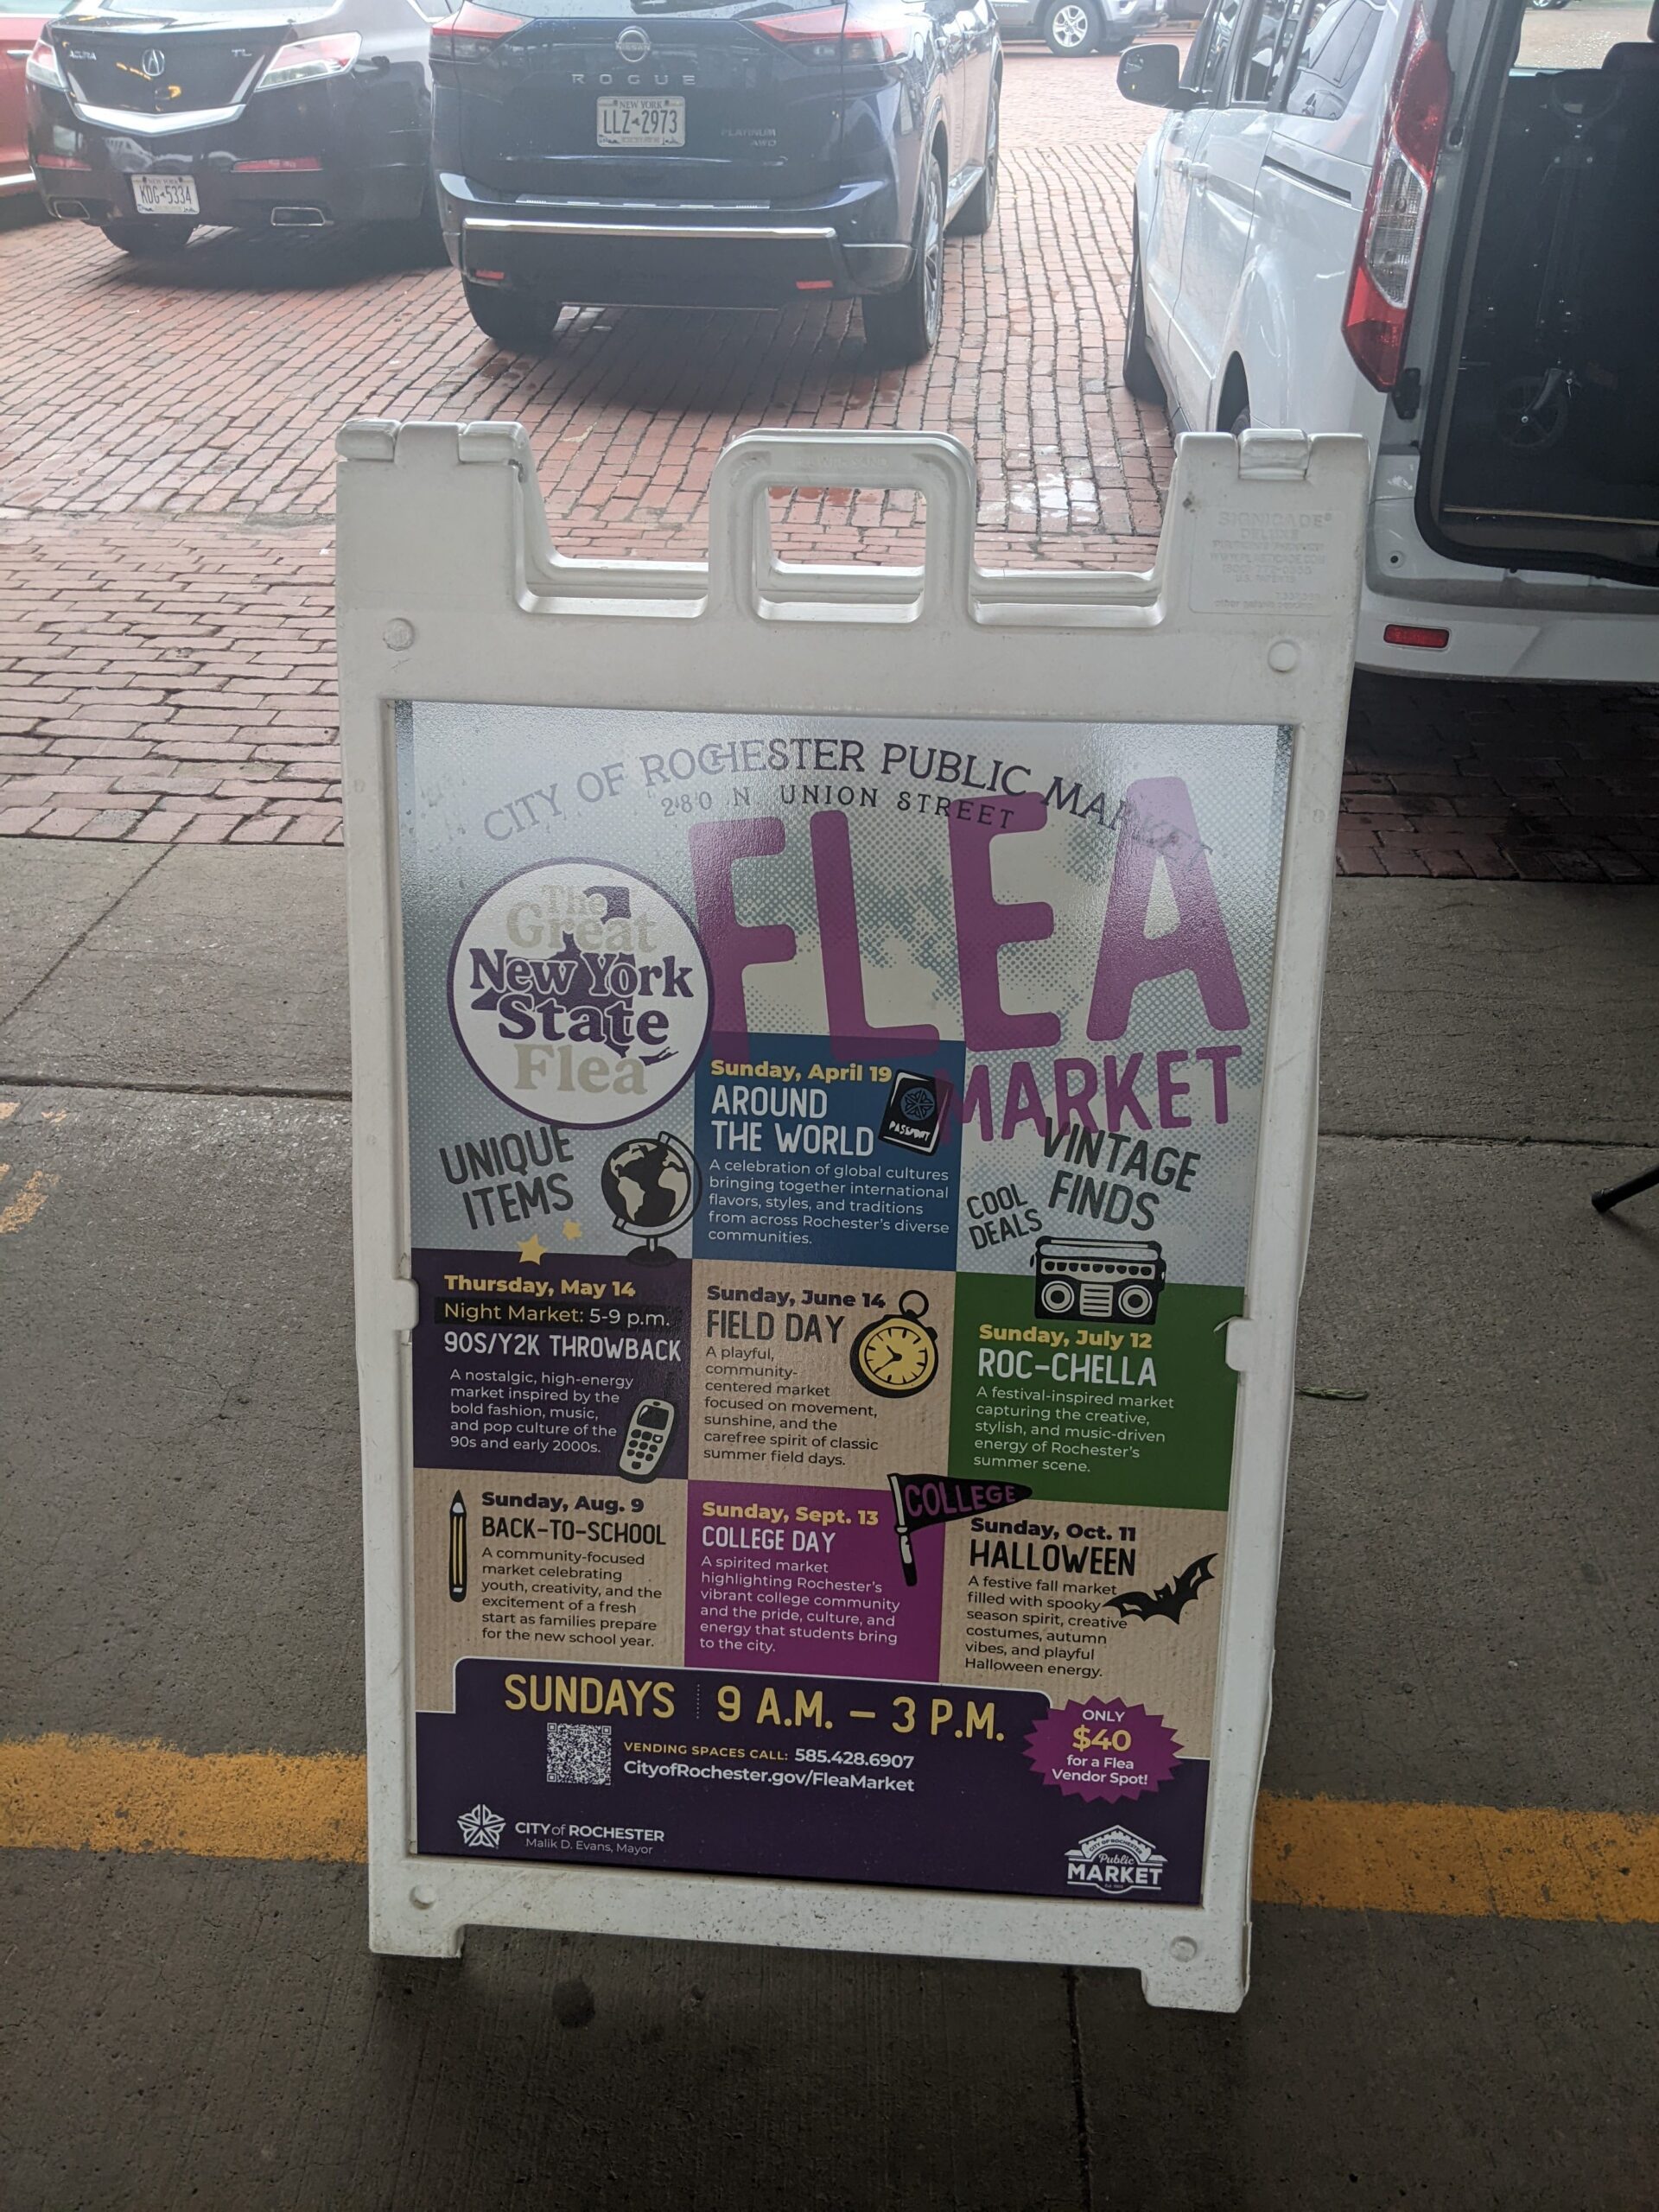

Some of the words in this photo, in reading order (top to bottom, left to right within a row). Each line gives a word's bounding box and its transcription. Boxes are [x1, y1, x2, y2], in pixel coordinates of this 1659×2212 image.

[572, 74, 696, 85] ROGUE
[484, 784, 563, 842] CITY
[576, 763, 626, 804] OF
[639, 738, 865, 788] ROCHESTER
[881, 742, 1032, 797] PUBLIC
[780, 784, 879, 808] UNION
[898, 790, 1015, 829] STREET
[506, 900, 657, 954] Great
[689, 776, 1251, 1063] FLEA
[469, 948, 577, 995] New
[585, 952, 695, 999] York
[498, 992, 670, 1044] State
[513, 1043, 648, 1096] Flea
[710, 1060, 801, 1082] Sunday,
[808, 1063, 862, 1084] April
[869, 1066, 892, 1082] 19
[711, 1085, 828, 1118] AROUND
[935, 1045, 1243, 1145] MARKET
[711, 1121, 762, 1151] THE
[774, 1122, 874, 1156] WORLD
[439, 1125, 574, 1185] UNIQUE
[1044, 1117, 1201, 1192] VINTAGE
[710, 1160, 721, 1170] A
[725, 1160, 810, 1174] celebration
[816, 1163, 830, 1175] of
[835, 1165, 881, 1179] global
[886, 1167, 949, 1180] cultures
[710, 1176, 774, 1192] bringing
[779, 1180, 846, 1194] together
[850, 1183, 949, 1198] international
[462, 1173, 574, 1230] ITEMS
[966, 1184, 1028, 1219] COOL
[1048, 1170, 1160, 1231] FINDS
[968, 1209, 1043, 1249] DEALS
[444, 1274, 554, 1297] Thursday,
[562, 1280, 607, 1299] May
[613, 1282, 636, 1297] 14
[707, 1285, 796, 1307] Sunday,
[802, 1289, 855, 1306] June
[862, 1293, 886, 1308] 14
[445, 1303, 501, 1322] Night
[508, 1305, 584, 1323] Market:
[589, 1309, 620, 1324] 5-9
[627, 1313, 670, 1327] p.m.
[707, 1310, 774, 1340] FIELD
[785, 1313, 845, 1344] DAY
[444, 1332, 540, 1356] 90S/Y2K
[550, 1335, 681, 1361] THROWBACK
[979, 1324, 1070, 1347] Sunday,
[1077, 1330, 1123, 1351] July
[1130, 1332, 1152, 1349] 12
[706, 1346, 716, 1357] A
[721, 1347, 774, 1362] playful,
[706, 1364, 798, 1378] community-
[978, 1348, 1157, 1386] ROC-CHELLA
[450, 1370, 461, 1380] A
[466, 1370, 537, 1385] nostalgic,
[542, 1373, 633, 1389] high-energy
[706, 1382, 772, 1394] centered
[777, 1385, 830, 1396] market
[976, 1386, 987, 1397] A
[992, 1387, 1113, 1405] festival-inspired
[1119, 1395, 1174, 1408] market
[451, 1403, 483, 1414] bold
[487, 1404, 545, 1418] fashion,
[550, 1408, 598, 1421] music,
[976, 1405, 1051, 1421] capturing
[1056, 1408, 1081, 1421] the
[1085, 1410, 1149, 1427] creative,
[482, 1491, 569, 1511] Sunday,
[575, 1496, 625, 1515] Aug.
[632, 1498, 644, 1512] 9
[905, 1482, 1016, 1517] COLLEGE
[702, 1502, 789, 1523] Sunday,
[795, 1507, 851, 1526] Sept.
[858, 1510, 879, 1525] 13
[482, 1516, 666, 1545] BACK-TO-SCHOOL
[702, 1526, 785, 1550] COLLEGE
[792, 1530, 836, 1553] DAY
[970, 1517, 1058, 1540] Sunday,
[1066, 1523, 1112, 1541] Oct.
[1119, 1527, 1135, 1541] 11
[482, 1548, 493, 1557] A
[497, 1548, 645, 1565] community-focused
[702, 1556, 712, 1567] A
[716, 1556, 771, 1570] spirited
[776, 1560, 829, 1573] market
[969, 1540, 1136, 1577] HALLOWEEN
[482, 1564, 534, 1576] market
[539, 1567, 622, 1582] celebrating
[702, 1573, 791, 1590] highlighting
[969, 1576, 979, 1586] A
[982, 1577, 1032, 1591] festive
[1037, 1580, 1058, 1592] fall
[1063, 1581, 1117, 1595] market
[968, 1592, 1005, 1605] filled
[1009, 1595, 1042, 1607] with
[1046, 1598, 1101, 1613] spooky
[505, 1674, 675, 1719] SUNDAYS
[717, 1685, 741, 1722] 9
[756, 1688, 833, 1729] A.M.
[892, 1696, 916, 1733] 3
[931, 1699, 1005, 1742] P.M.
[1083, 1710, 1125, 1722] ONLY
[1072, 1725, 1132, 1751] $40
[624, 1741, 687, 1755] VENDING
[691, 1745, 745, 1758] SPACES
[750, 1749, 788, 1761] CALL:
[794, 1748, 914, 1769] 585.428.6907
[1067, 1754, 1088, 1766] for
[1104, 1758, 1134, 1769] Flea
[623, 1760, 915, 1792] CityofRochester.gov/FleaMarket
[1052, 1769, 1106, 1783] Vendor
[1109, 1772, 1147, 1786] Spot!
[515, 1821, 550, 1834] CITY
[551, 1824, 566, 1835] of
[569, 1825, 664, 1842] ROCHESTER
[526, 1838, 557, 1849] Malik
[561, 1840, 573, 1850] D.
[576, 1841, 613, 1853] Evans,
[617, 1843, 652, 1856] Mayor
[1090, 1842, 1100, 1852] CITY
[1111, 1839, 1142, 1854] ROCHESTER
[1099, 1853, 1135, 1865] Public
[1068, 1863, 1163, 1885] MARKET
